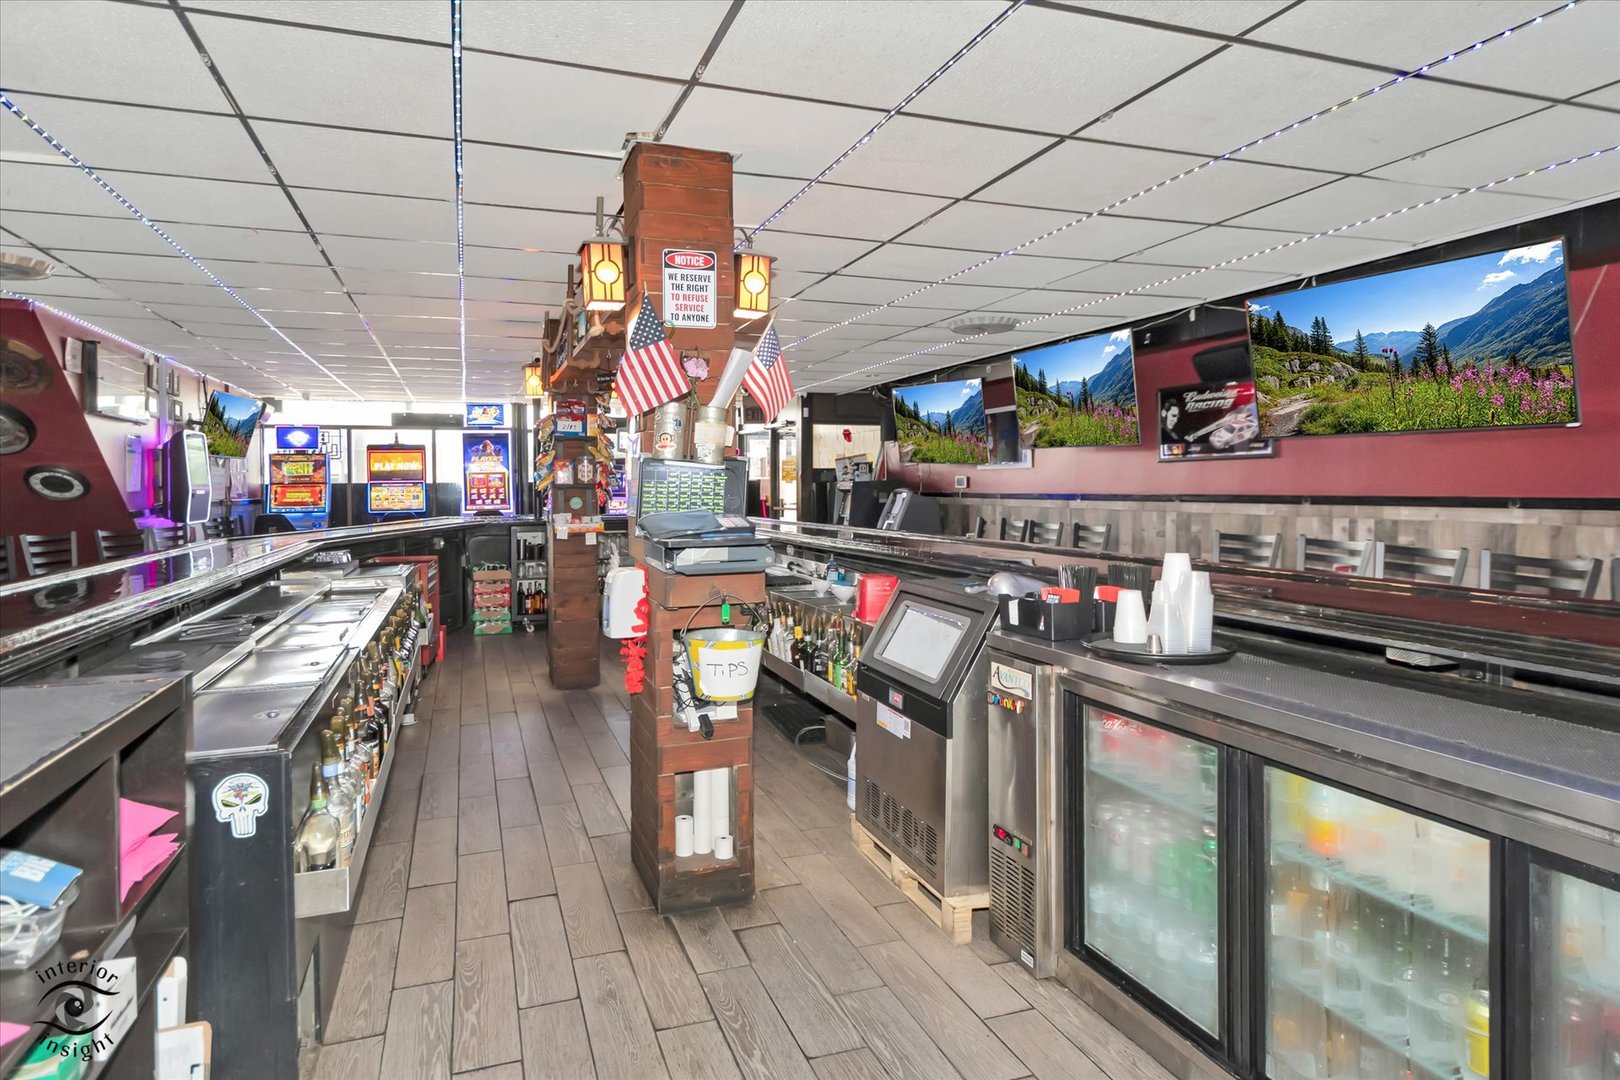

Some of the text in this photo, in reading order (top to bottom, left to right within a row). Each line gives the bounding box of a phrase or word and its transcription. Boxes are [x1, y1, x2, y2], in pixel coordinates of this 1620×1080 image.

[674, 255, 705, 266] NOTICE
[668, 273, 711, 283] WE RESERVE
[671, 283, 708, 292] THE RIGHT
[671, 293, 708, 302] TO REFUSE
[675, 303, 704, 312] SERVICE
[670, 313, 709, 322] TO ANYONE
[374, 462, 394, 471] PLAY
